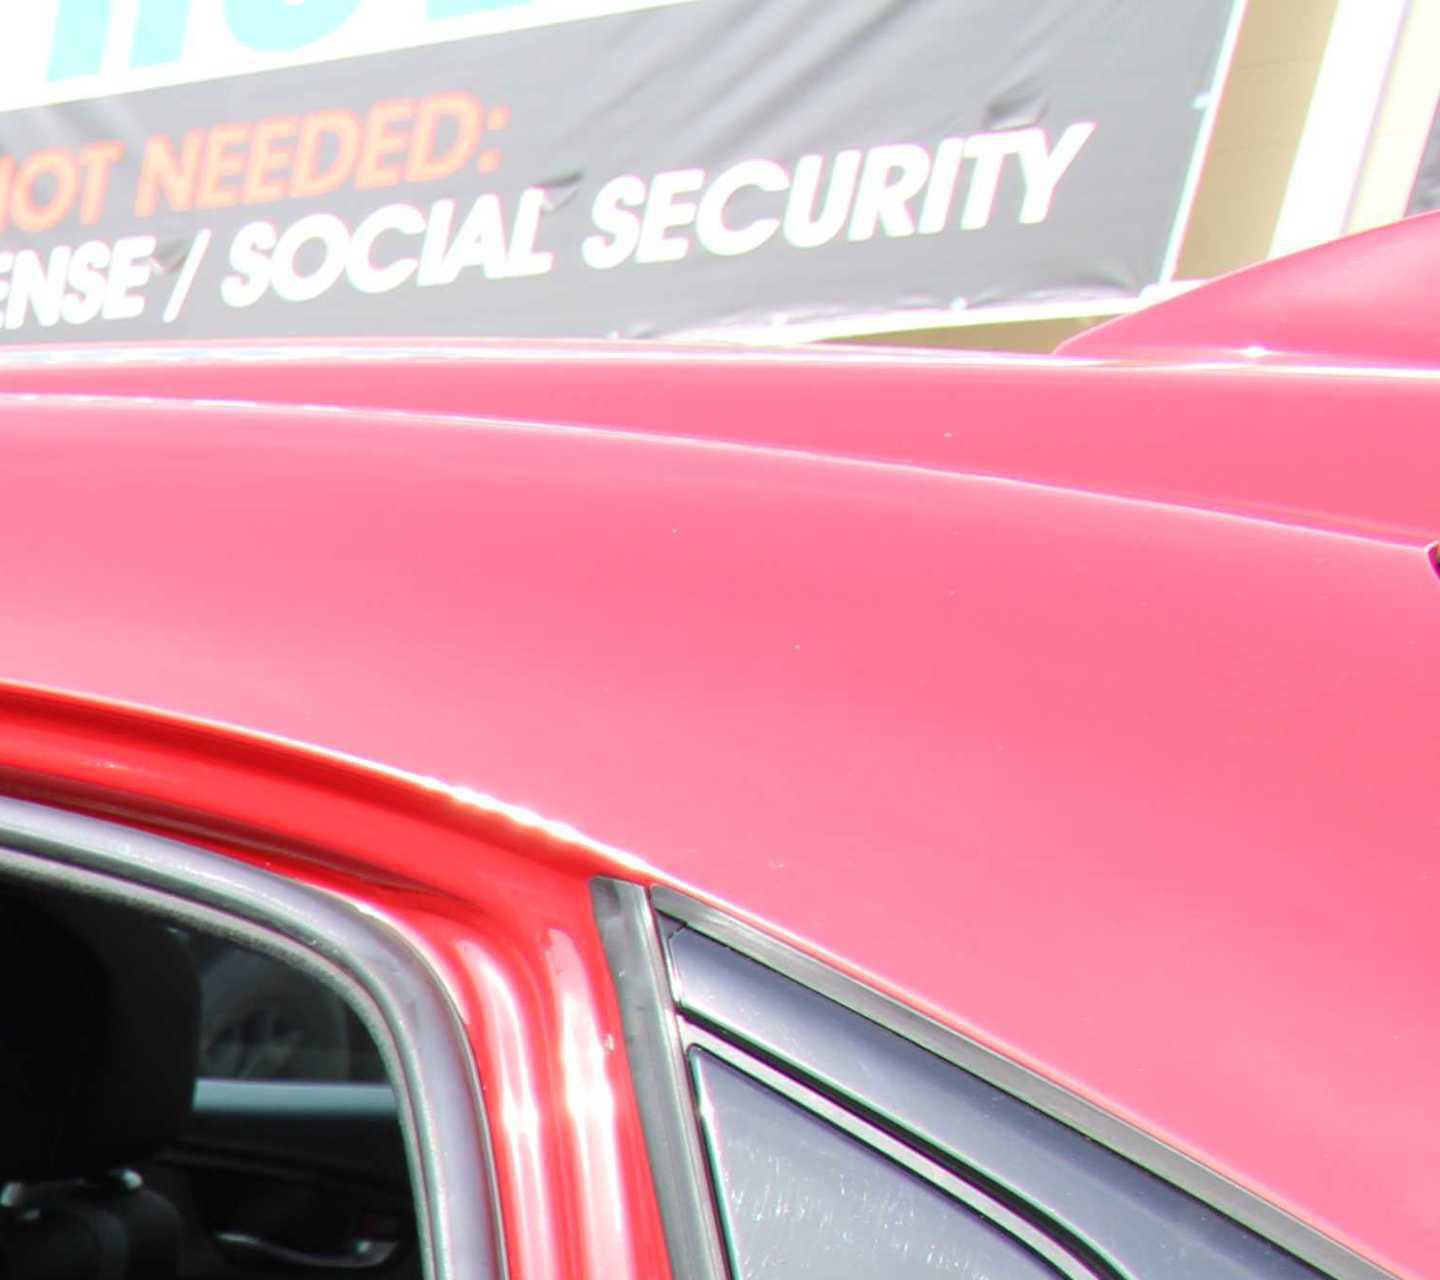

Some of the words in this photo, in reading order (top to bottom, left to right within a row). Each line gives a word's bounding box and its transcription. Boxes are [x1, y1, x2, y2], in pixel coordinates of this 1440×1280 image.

[133, 90, 512, 219] NEEDED:
[165, 228, 211, 322] /
[219, 187, 555, 308] SOCIAL
[582, 122, 1096, 267] SECURITY
